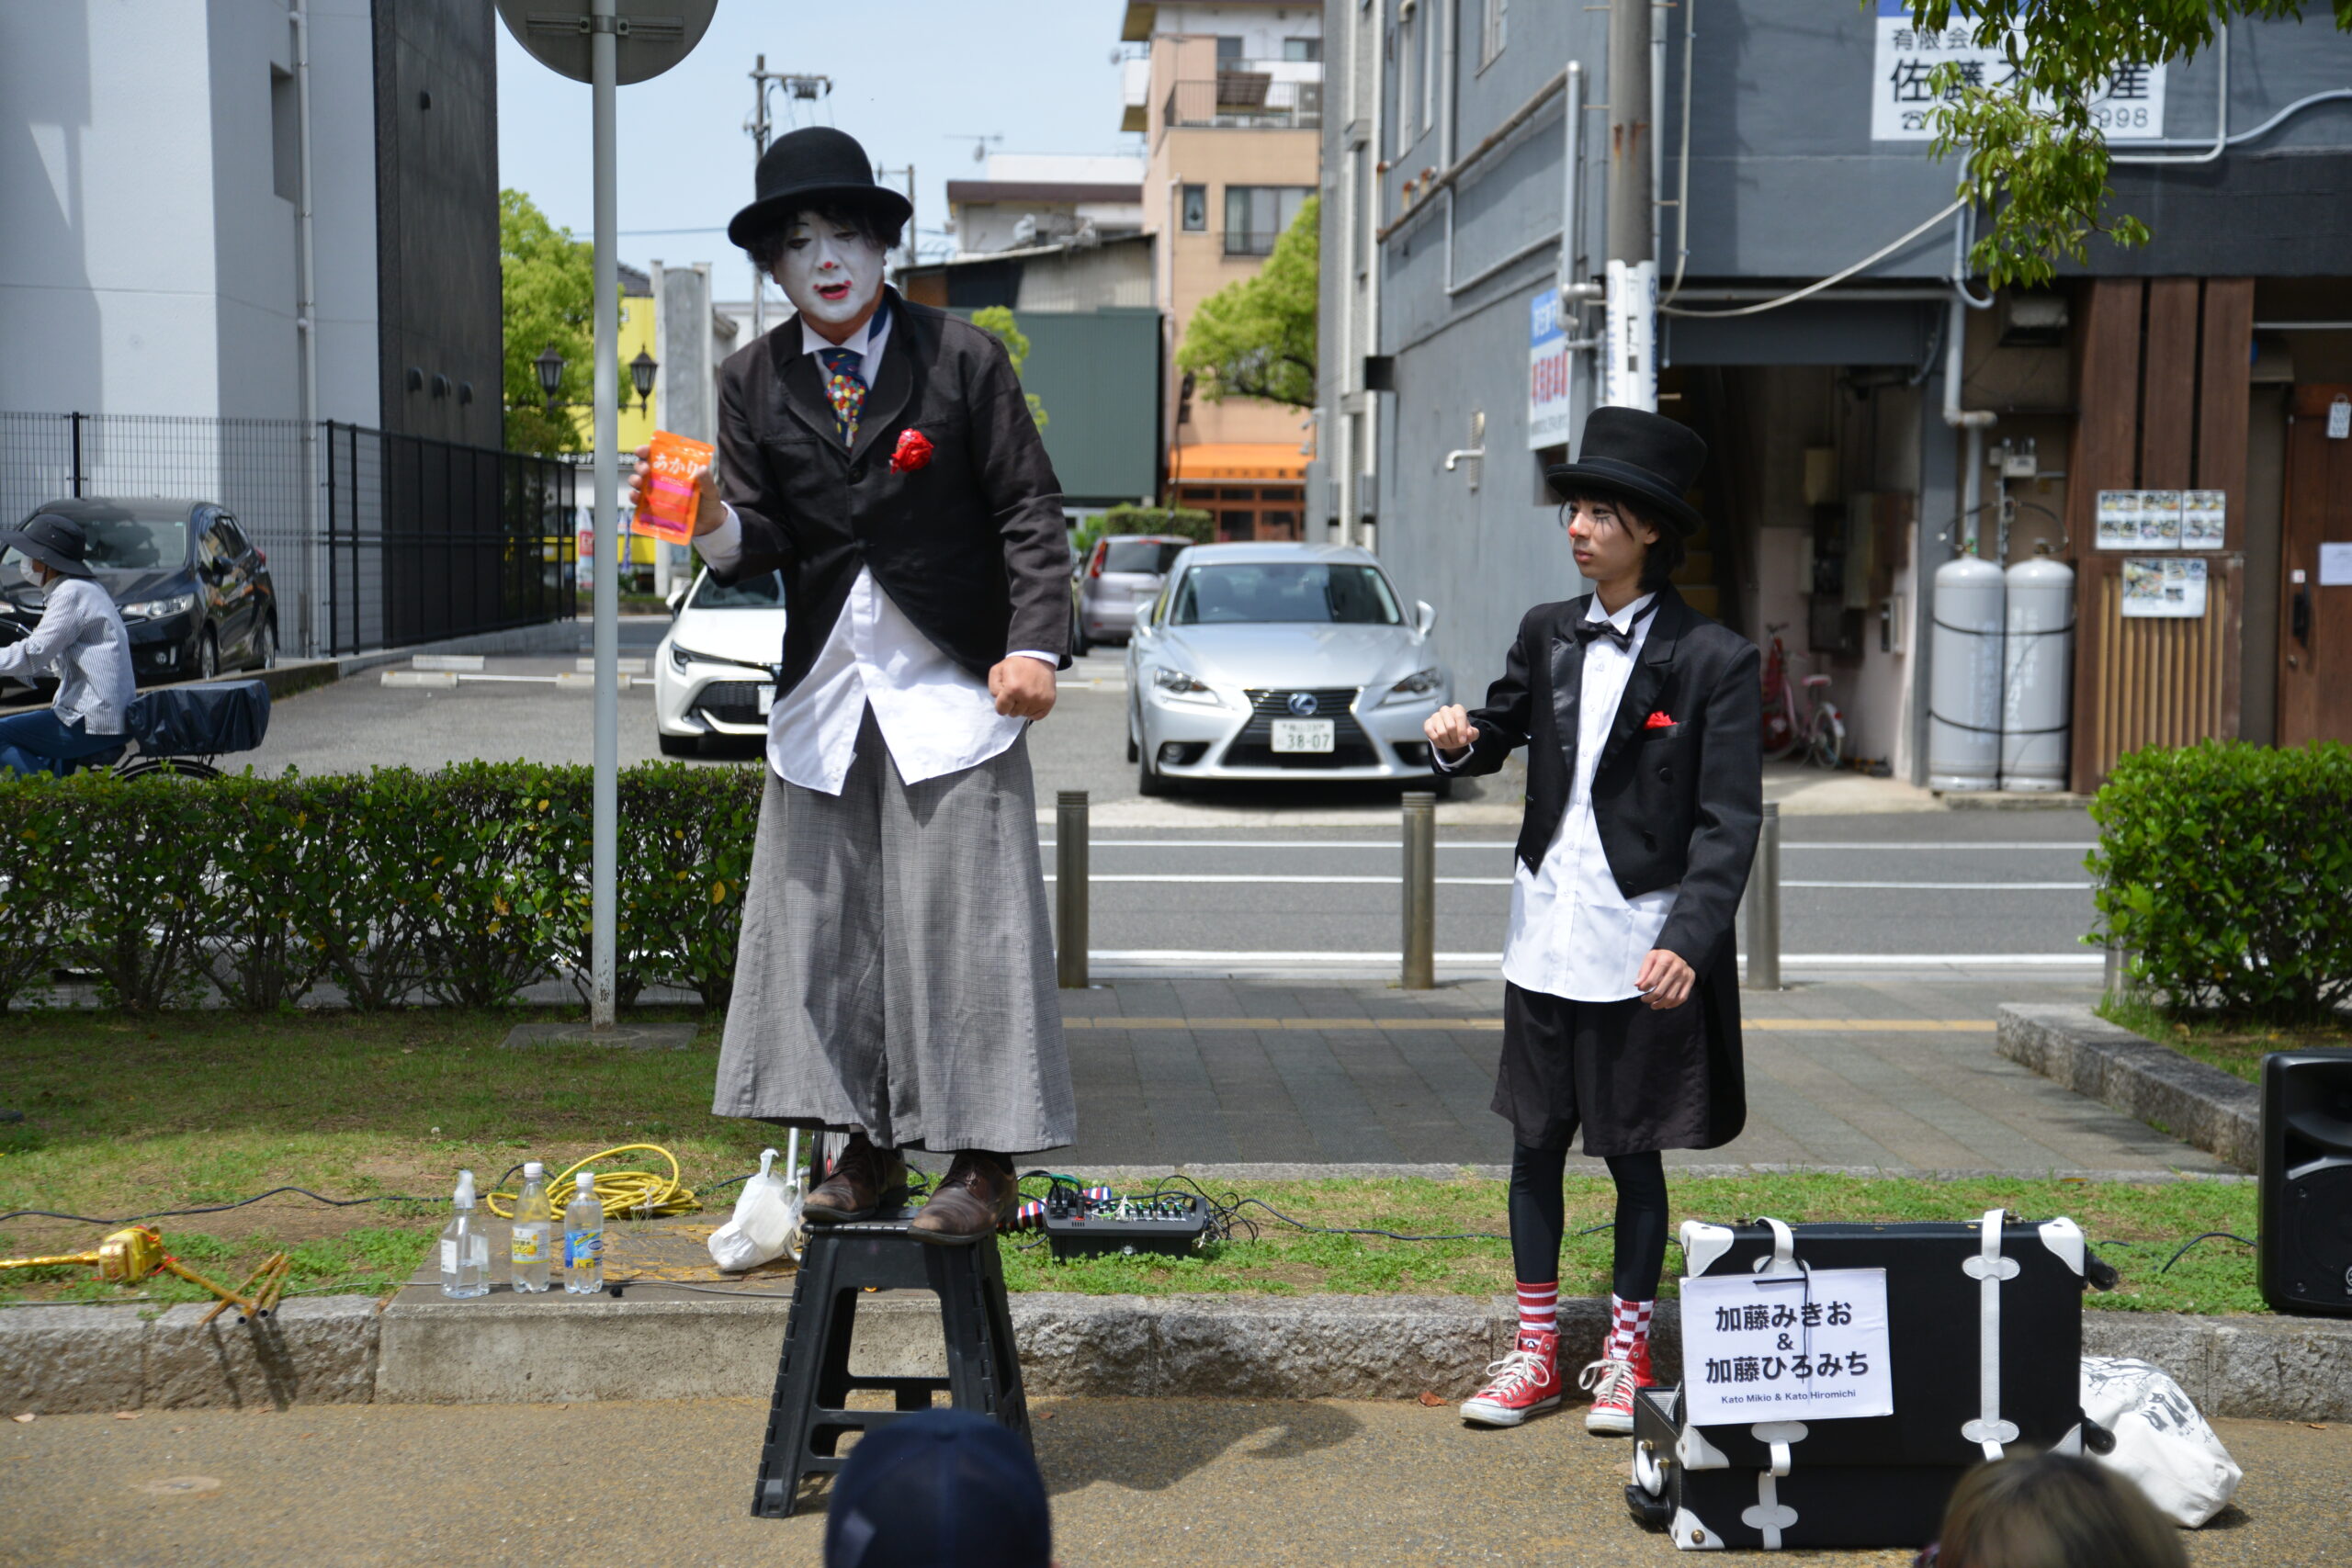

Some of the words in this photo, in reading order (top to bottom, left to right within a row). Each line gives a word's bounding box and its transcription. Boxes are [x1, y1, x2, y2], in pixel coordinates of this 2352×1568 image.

[1287, 734, 1330, 749] 38-07
[1715, 1301, 1852, 1332] 加藤みきお
[1777, 1333, 1794, 1350] &
[1705, 1351, 1870, 1384] 加藤ひろみち
[1721, 1395, 1744, 1404] Kato
[1747, 1394, 1772, 1403] Mikio
[1775, 1393, 1782, 1402] &
[1785, 1392, 1808, 1401] Kato
[1810, 1389, 1856, 1399] Hiromichi
